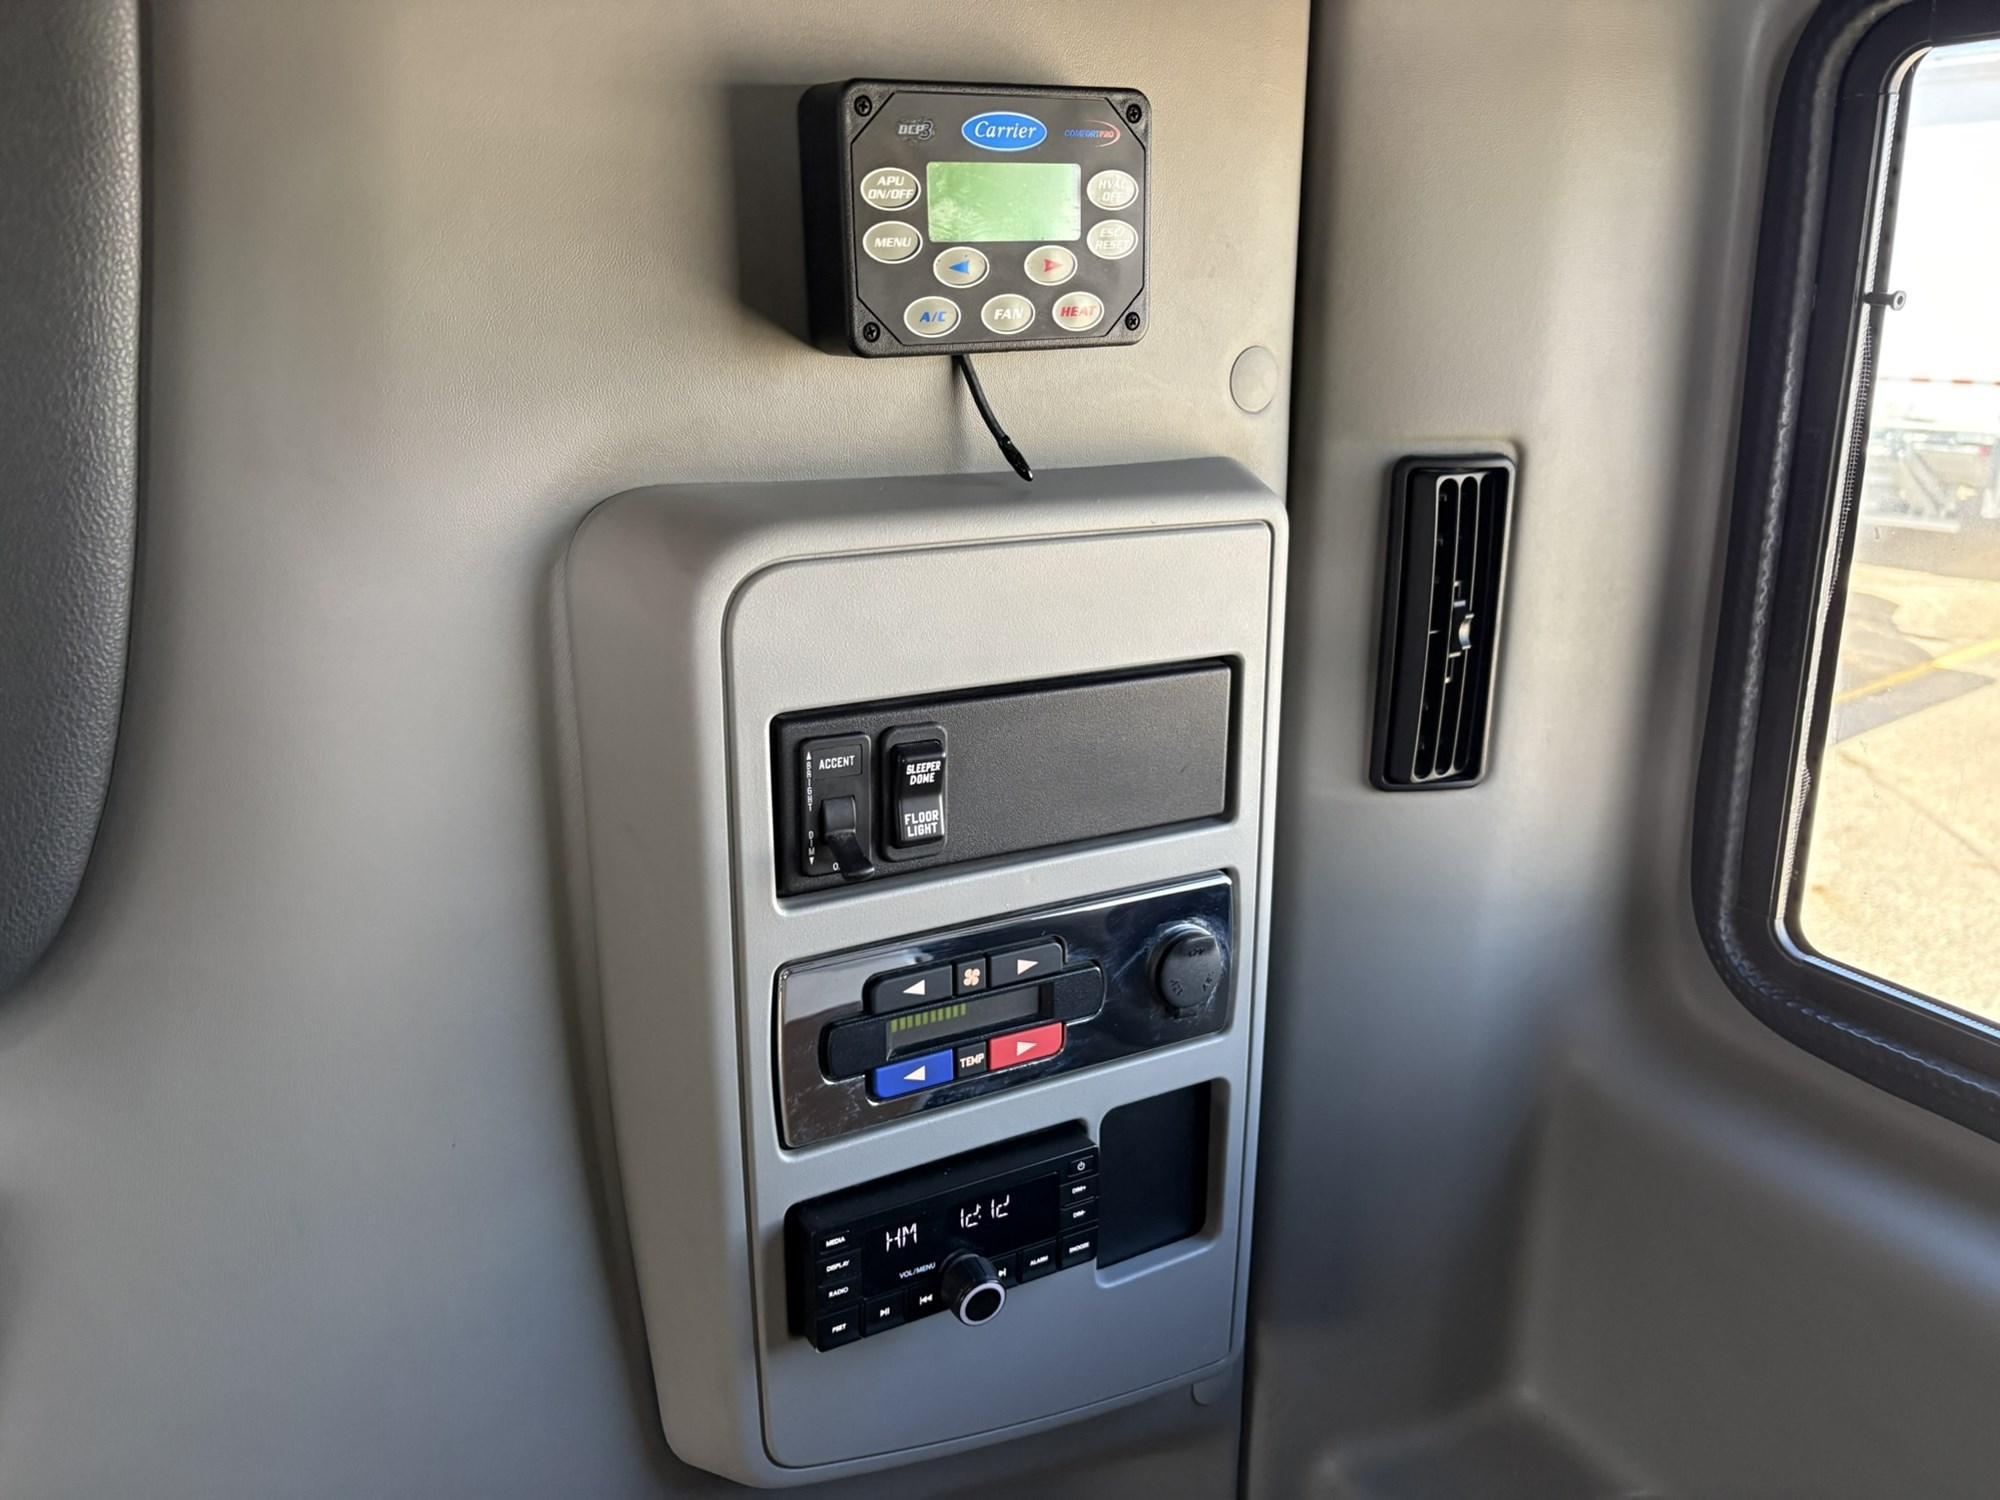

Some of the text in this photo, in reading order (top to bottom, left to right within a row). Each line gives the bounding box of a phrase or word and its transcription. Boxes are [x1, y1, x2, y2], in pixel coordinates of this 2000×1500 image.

[974, 120, 1037, 139] Carrier
[877, 175, 905, 186] APU
[867, 188, 914, 200] ON/OFF
[874, 237, 912, 248] MENU
[1095, 239, 1130, 250] RESET
[919, 311, 947, 323] A/C
[994, 308, 1023, 320] FAN
[1060, 305, 1097, 318] HEAT
[819, 755, 855, 770] ACCENT
[906, 760, 941, 775] SLEEPER
[909, 772, 935, 786] DOME
[904, 809, 939, 826] FLOOR
[907, 822, 938, 837] LIGHT
[960, 1053, 984, 1068] TEMP
[825, 1236, 846, 1248] MEDIA
[885, 1222, 917, 1252] HM
[826, 1260, 850, 1273] DISPLAY
[1030, 1255, 1049, 1266] ALARM
[899, 1262, 937, 1279] VOL/MENU
[828, 1286, 849, 1298] RADIO
